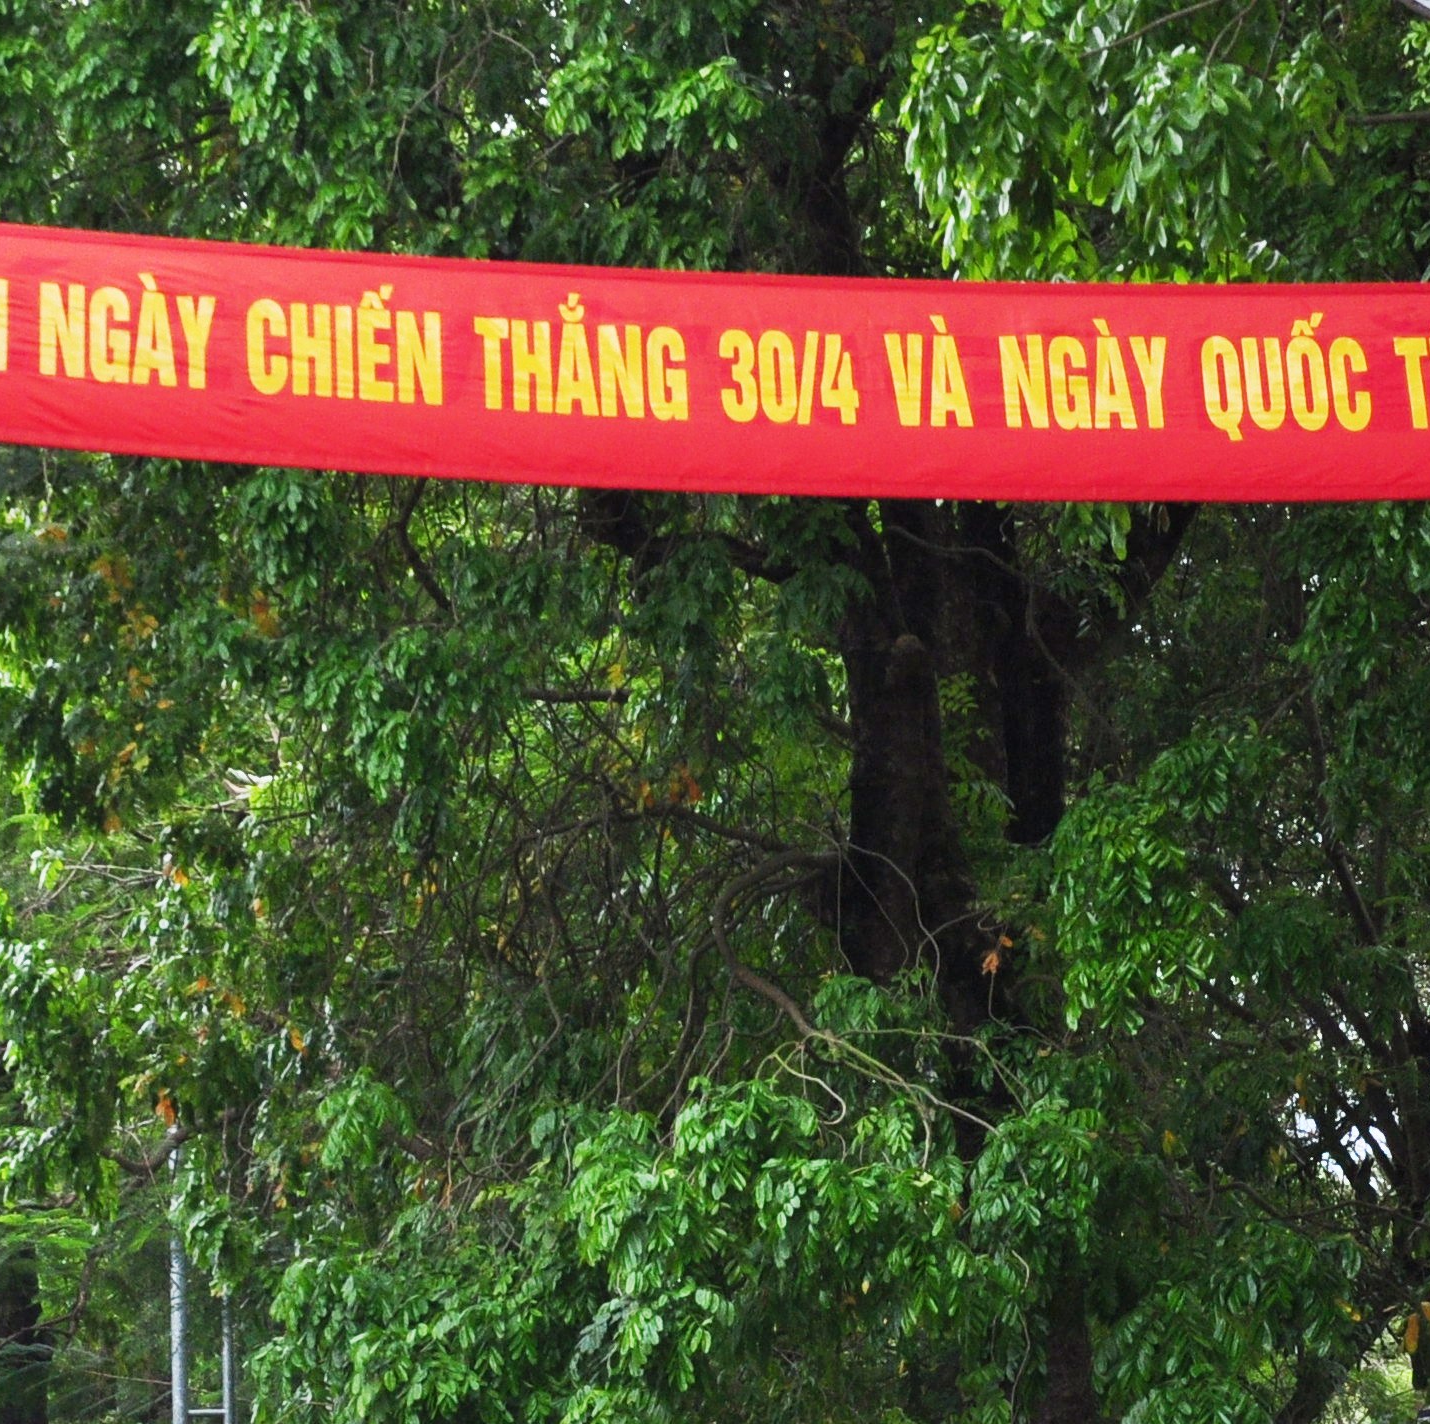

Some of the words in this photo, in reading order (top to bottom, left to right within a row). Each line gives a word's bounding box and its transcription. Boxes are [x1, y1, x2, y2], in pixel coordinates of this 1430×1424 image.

[39, 272, 216, 389] NGÀY
[246, 283, 443, 406] CHIẾN
[474, 292, 689, 421] THẮNG
[719, 329, 860, 425] 30/4
[884, 314, 974, 427] VÀ
[1000, 318, 1167, 430] NGÀY
[1201, 311, 1373, 441] QUỐC
